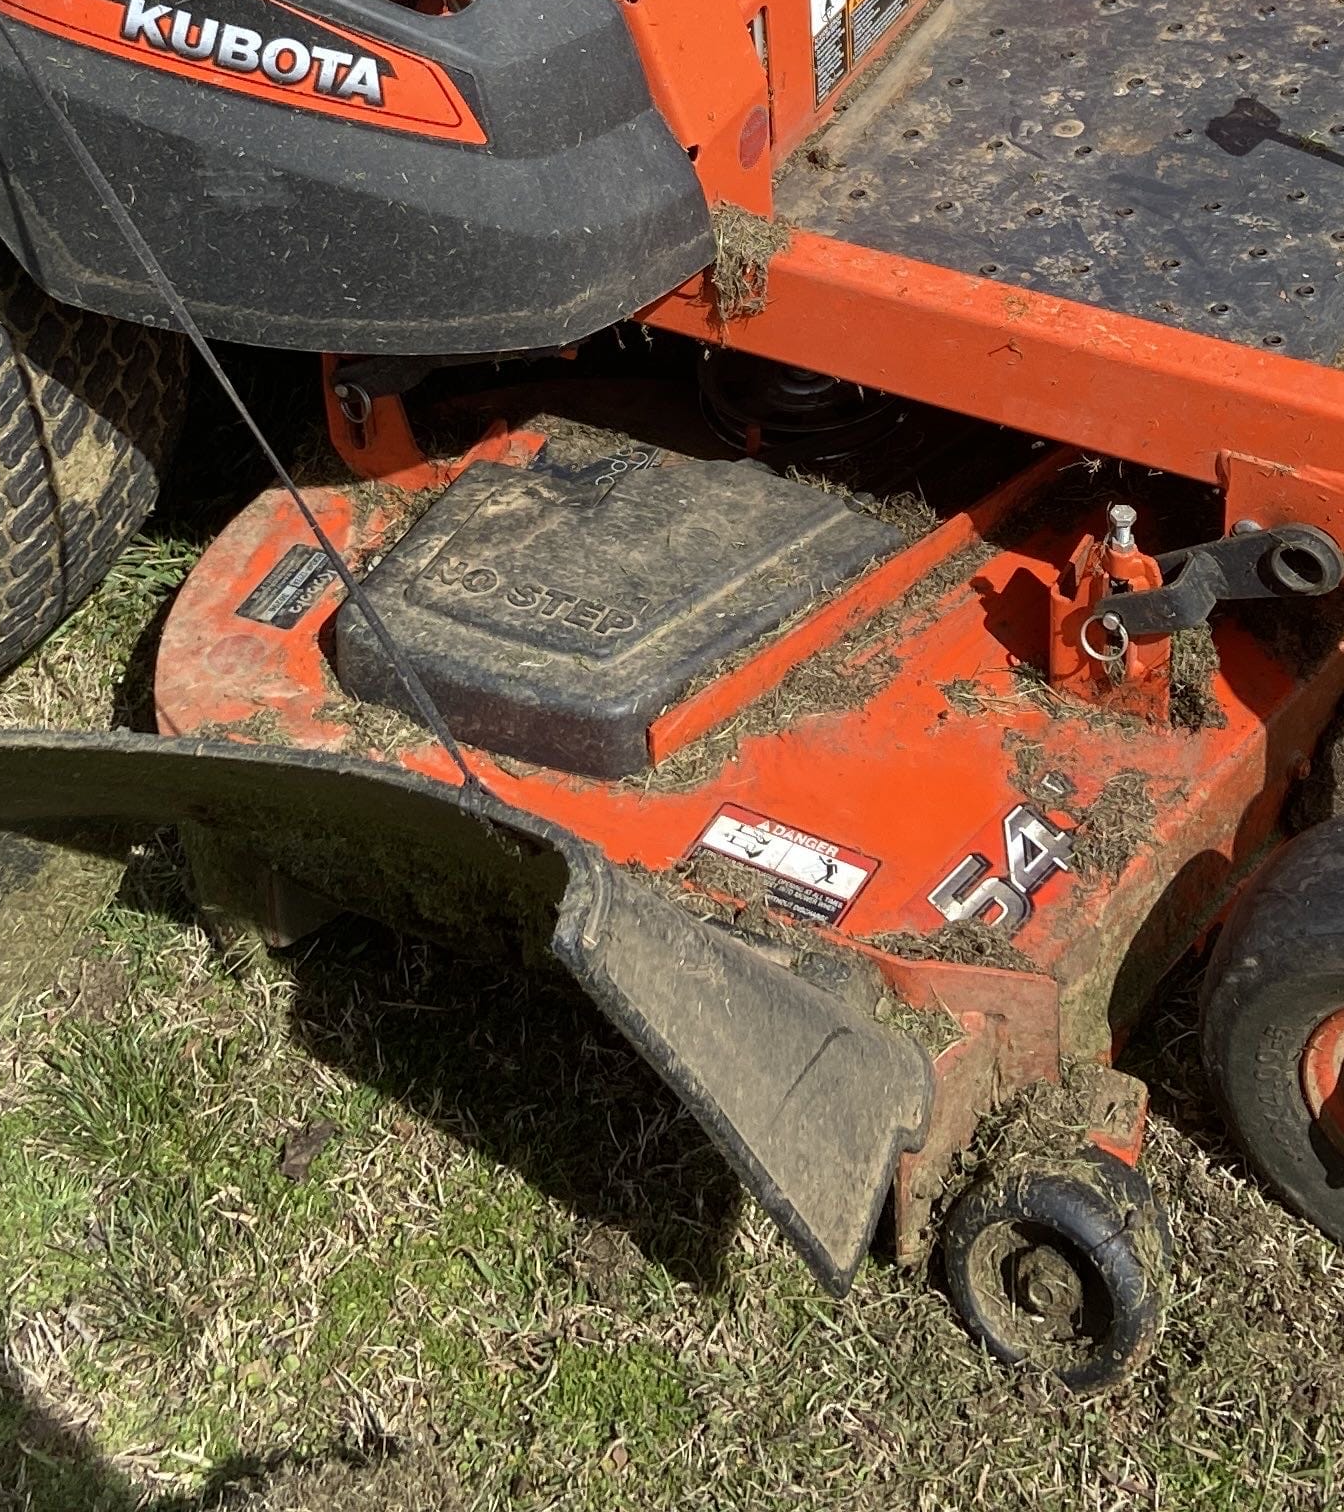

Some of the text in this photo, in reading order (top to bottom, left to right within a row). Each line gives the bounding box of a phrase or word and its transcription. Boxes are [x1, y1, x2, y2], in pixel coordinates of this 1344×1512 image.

[423, 556, 638, 636] NO STEP
[773, 821, 840, 857] DANGER
